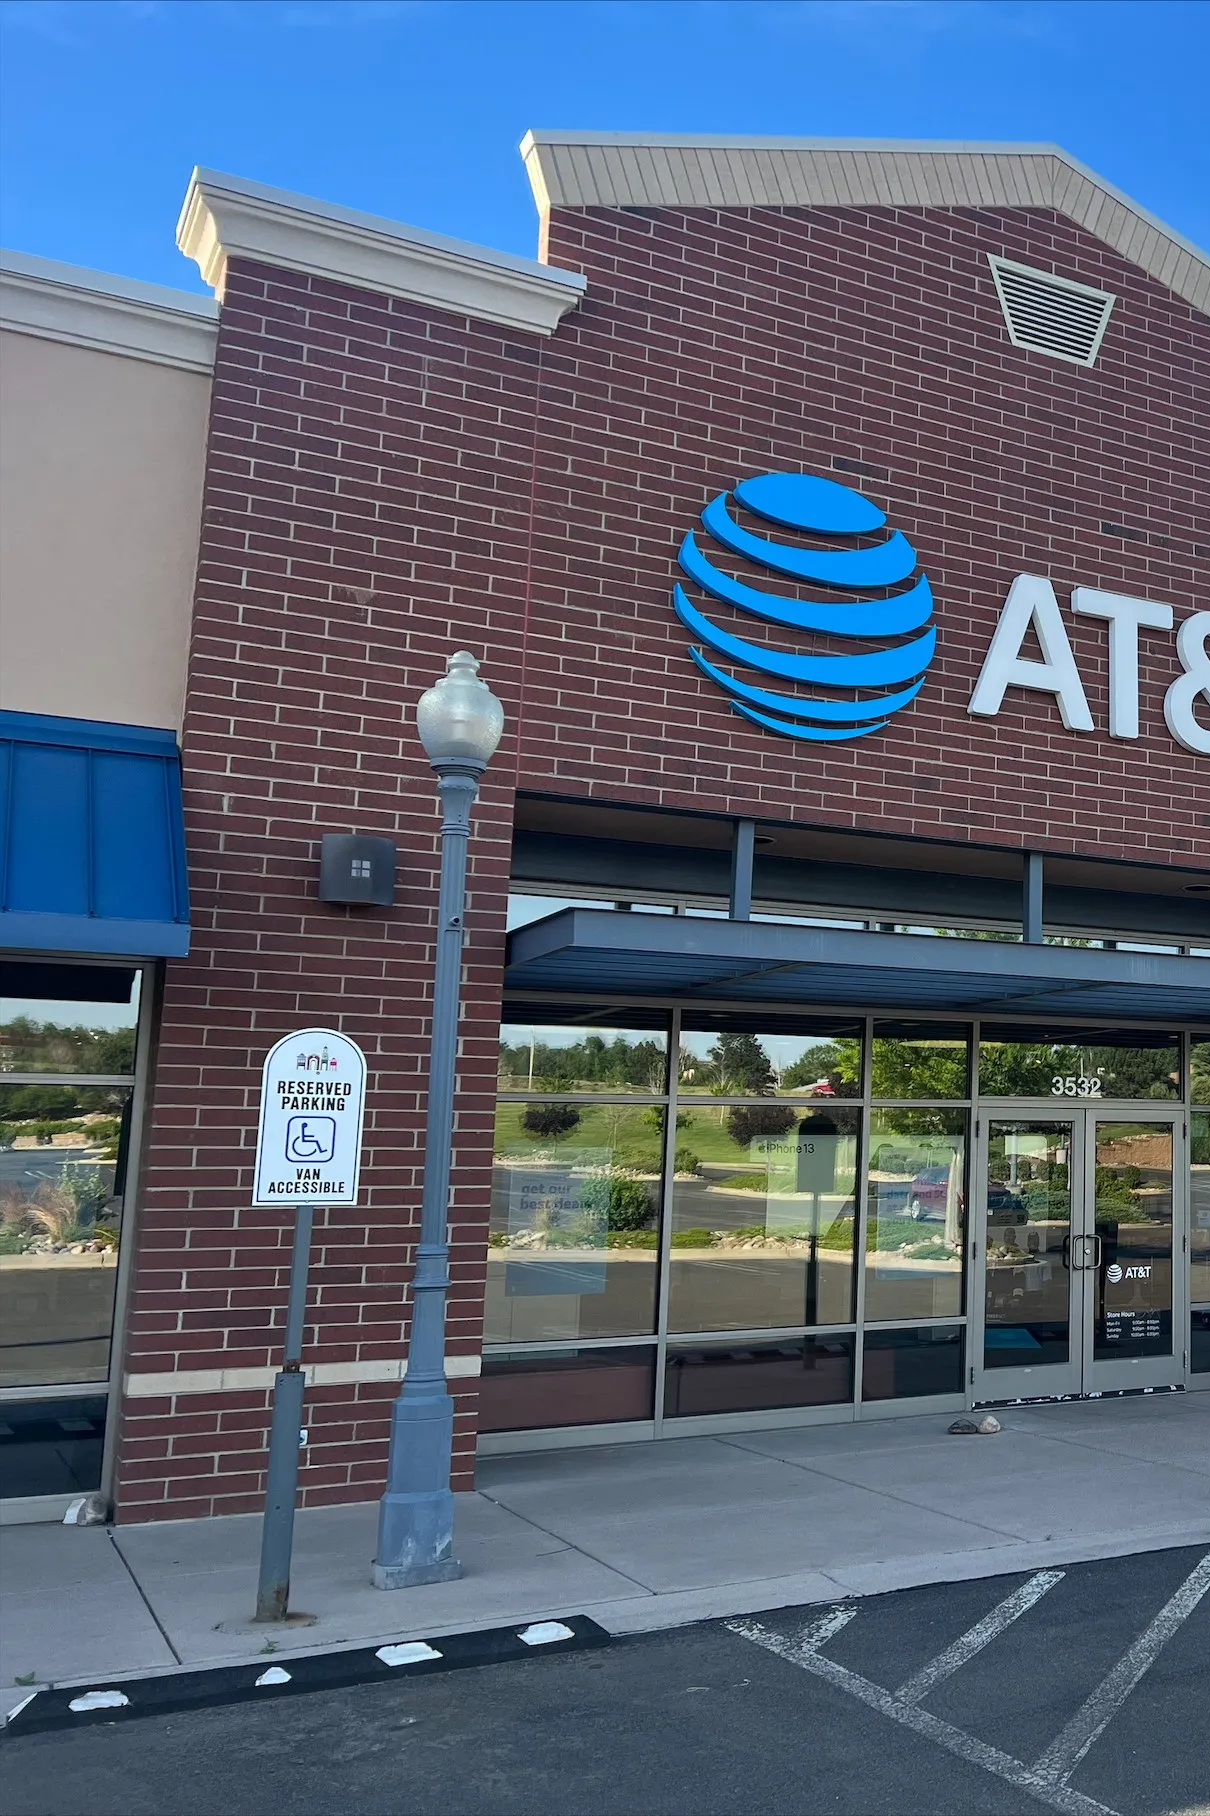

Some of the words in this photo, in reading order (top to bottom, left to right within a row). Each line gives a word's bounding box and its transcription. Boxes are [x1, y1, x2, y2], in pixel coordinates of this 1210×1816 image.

[277, 1081, 351, 1096] RESERVED
[1051, 1076, 1101, 1097] 3532
[281, 1096, 345, 1111] PARKING
[766, 1143, 802, 1154] iPhone
[803, 1143, 815, 1154] 13
[296, 1168, 321, 1180] VAN
[268, 1181, 345, 1194] ACCESSIBLE
[521, 1182, 545, 1195] get
[549, 1185, 573, 1195] our
[1125, 1266, 1151, 1279] AT&T
